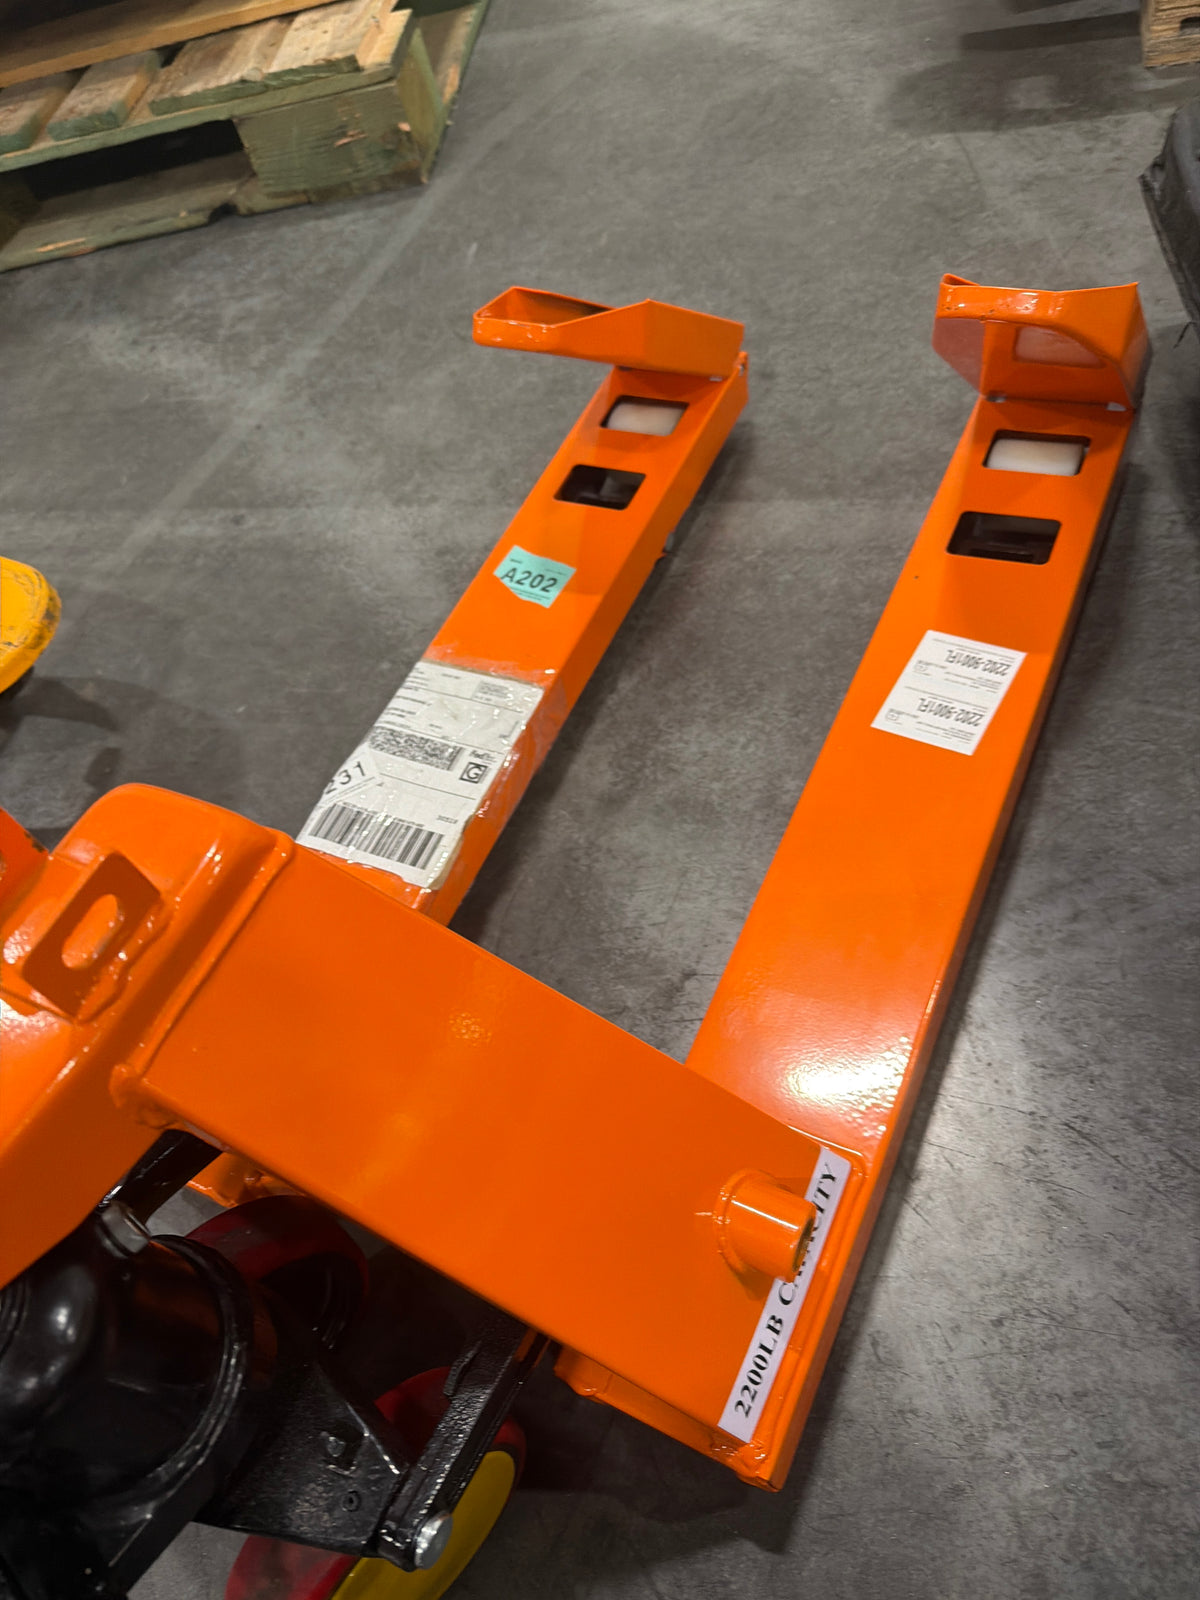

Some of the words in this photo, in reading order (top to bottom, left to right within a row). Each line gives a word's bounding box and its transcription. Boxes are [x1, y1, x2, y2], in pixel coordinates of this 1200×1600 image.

[500, 567, 558, 593] A202
[734, 1314, 784, 1418] 2200LB
[779, 1162, 837, 1306] CITY
